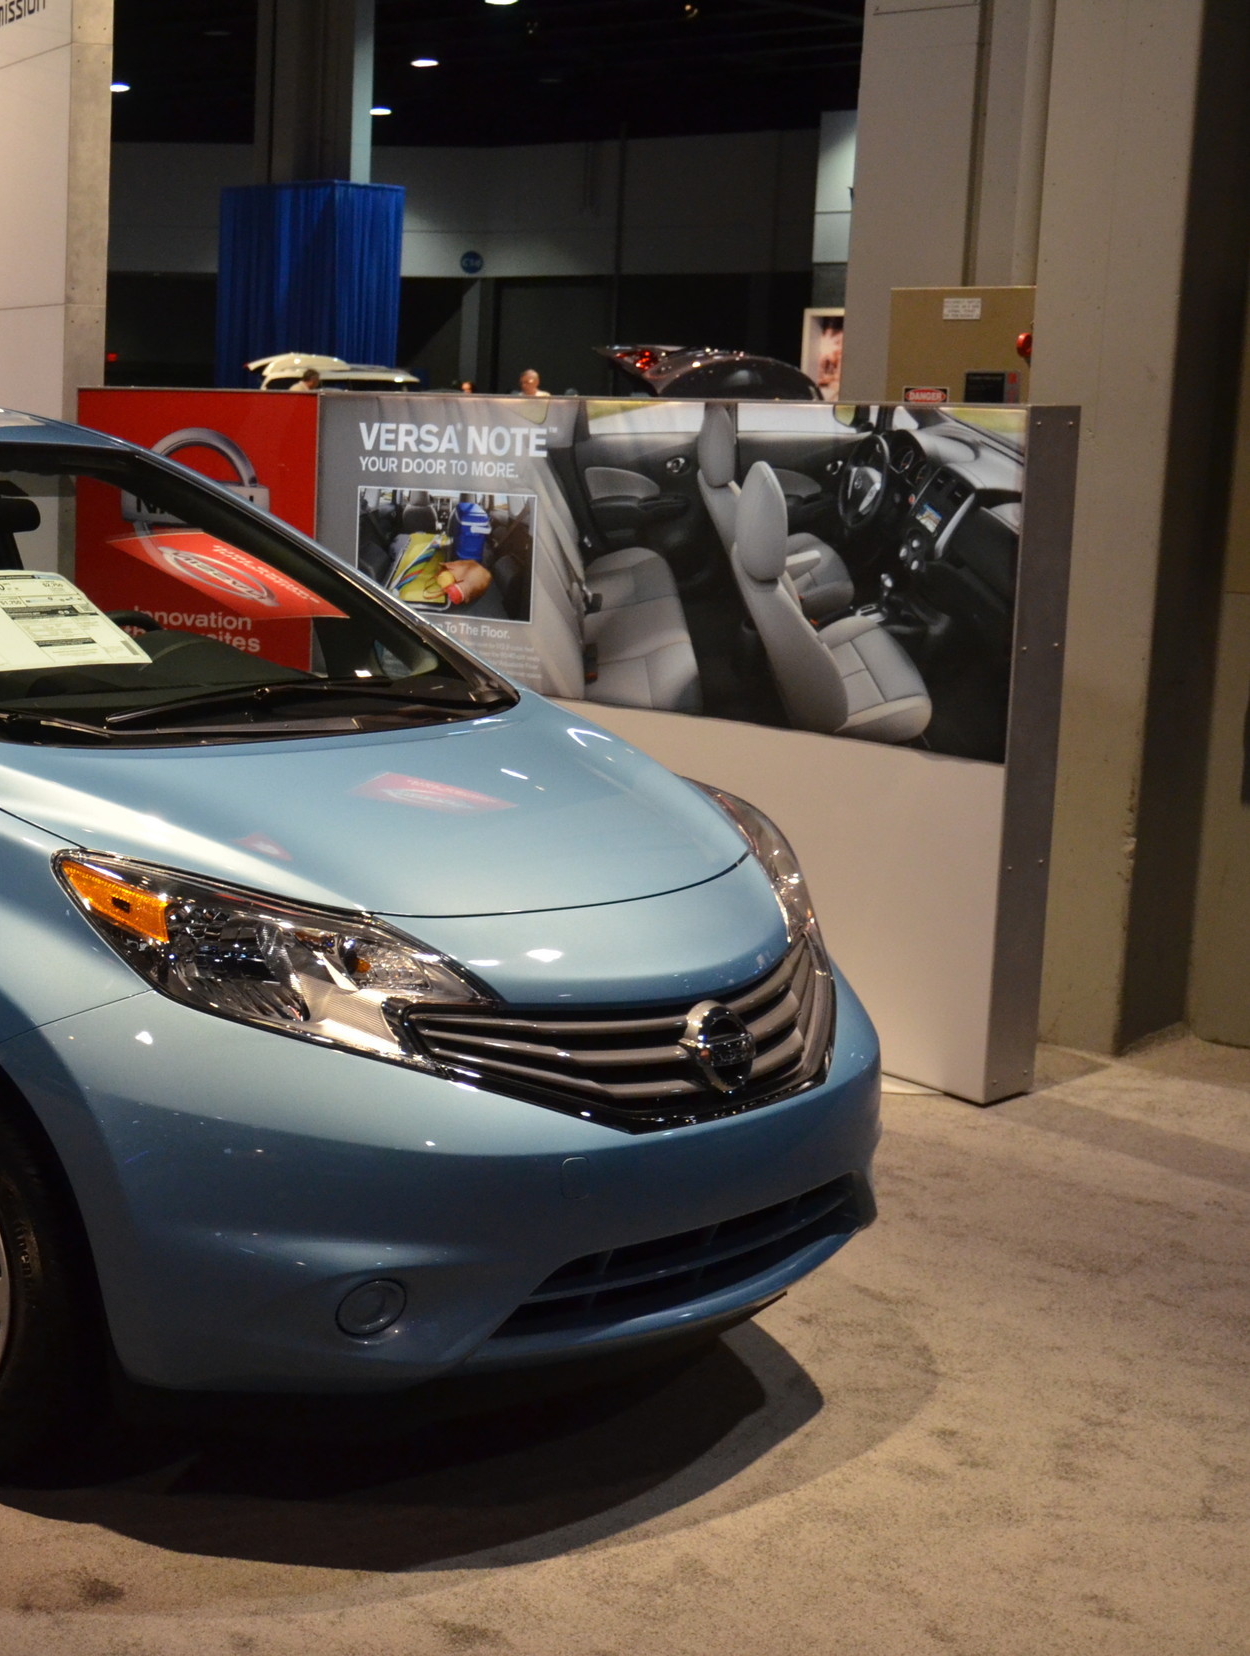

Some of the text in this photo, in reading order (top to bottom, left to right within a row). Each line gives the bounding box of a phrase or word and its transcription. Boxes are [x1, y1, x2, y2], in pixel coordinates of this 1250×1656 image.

[907, 391, 943, 401] DANGER
[359, 422, 548, 458] VERSA NOTE
[359, 456, 519, 479] YOUR DOOR TO MORE.
[133, 605, 252, 631] novation
[444, 621, 457, 634] To
[458, 622, 479, 636] The
[480, 624, 511, 640] Floor.
